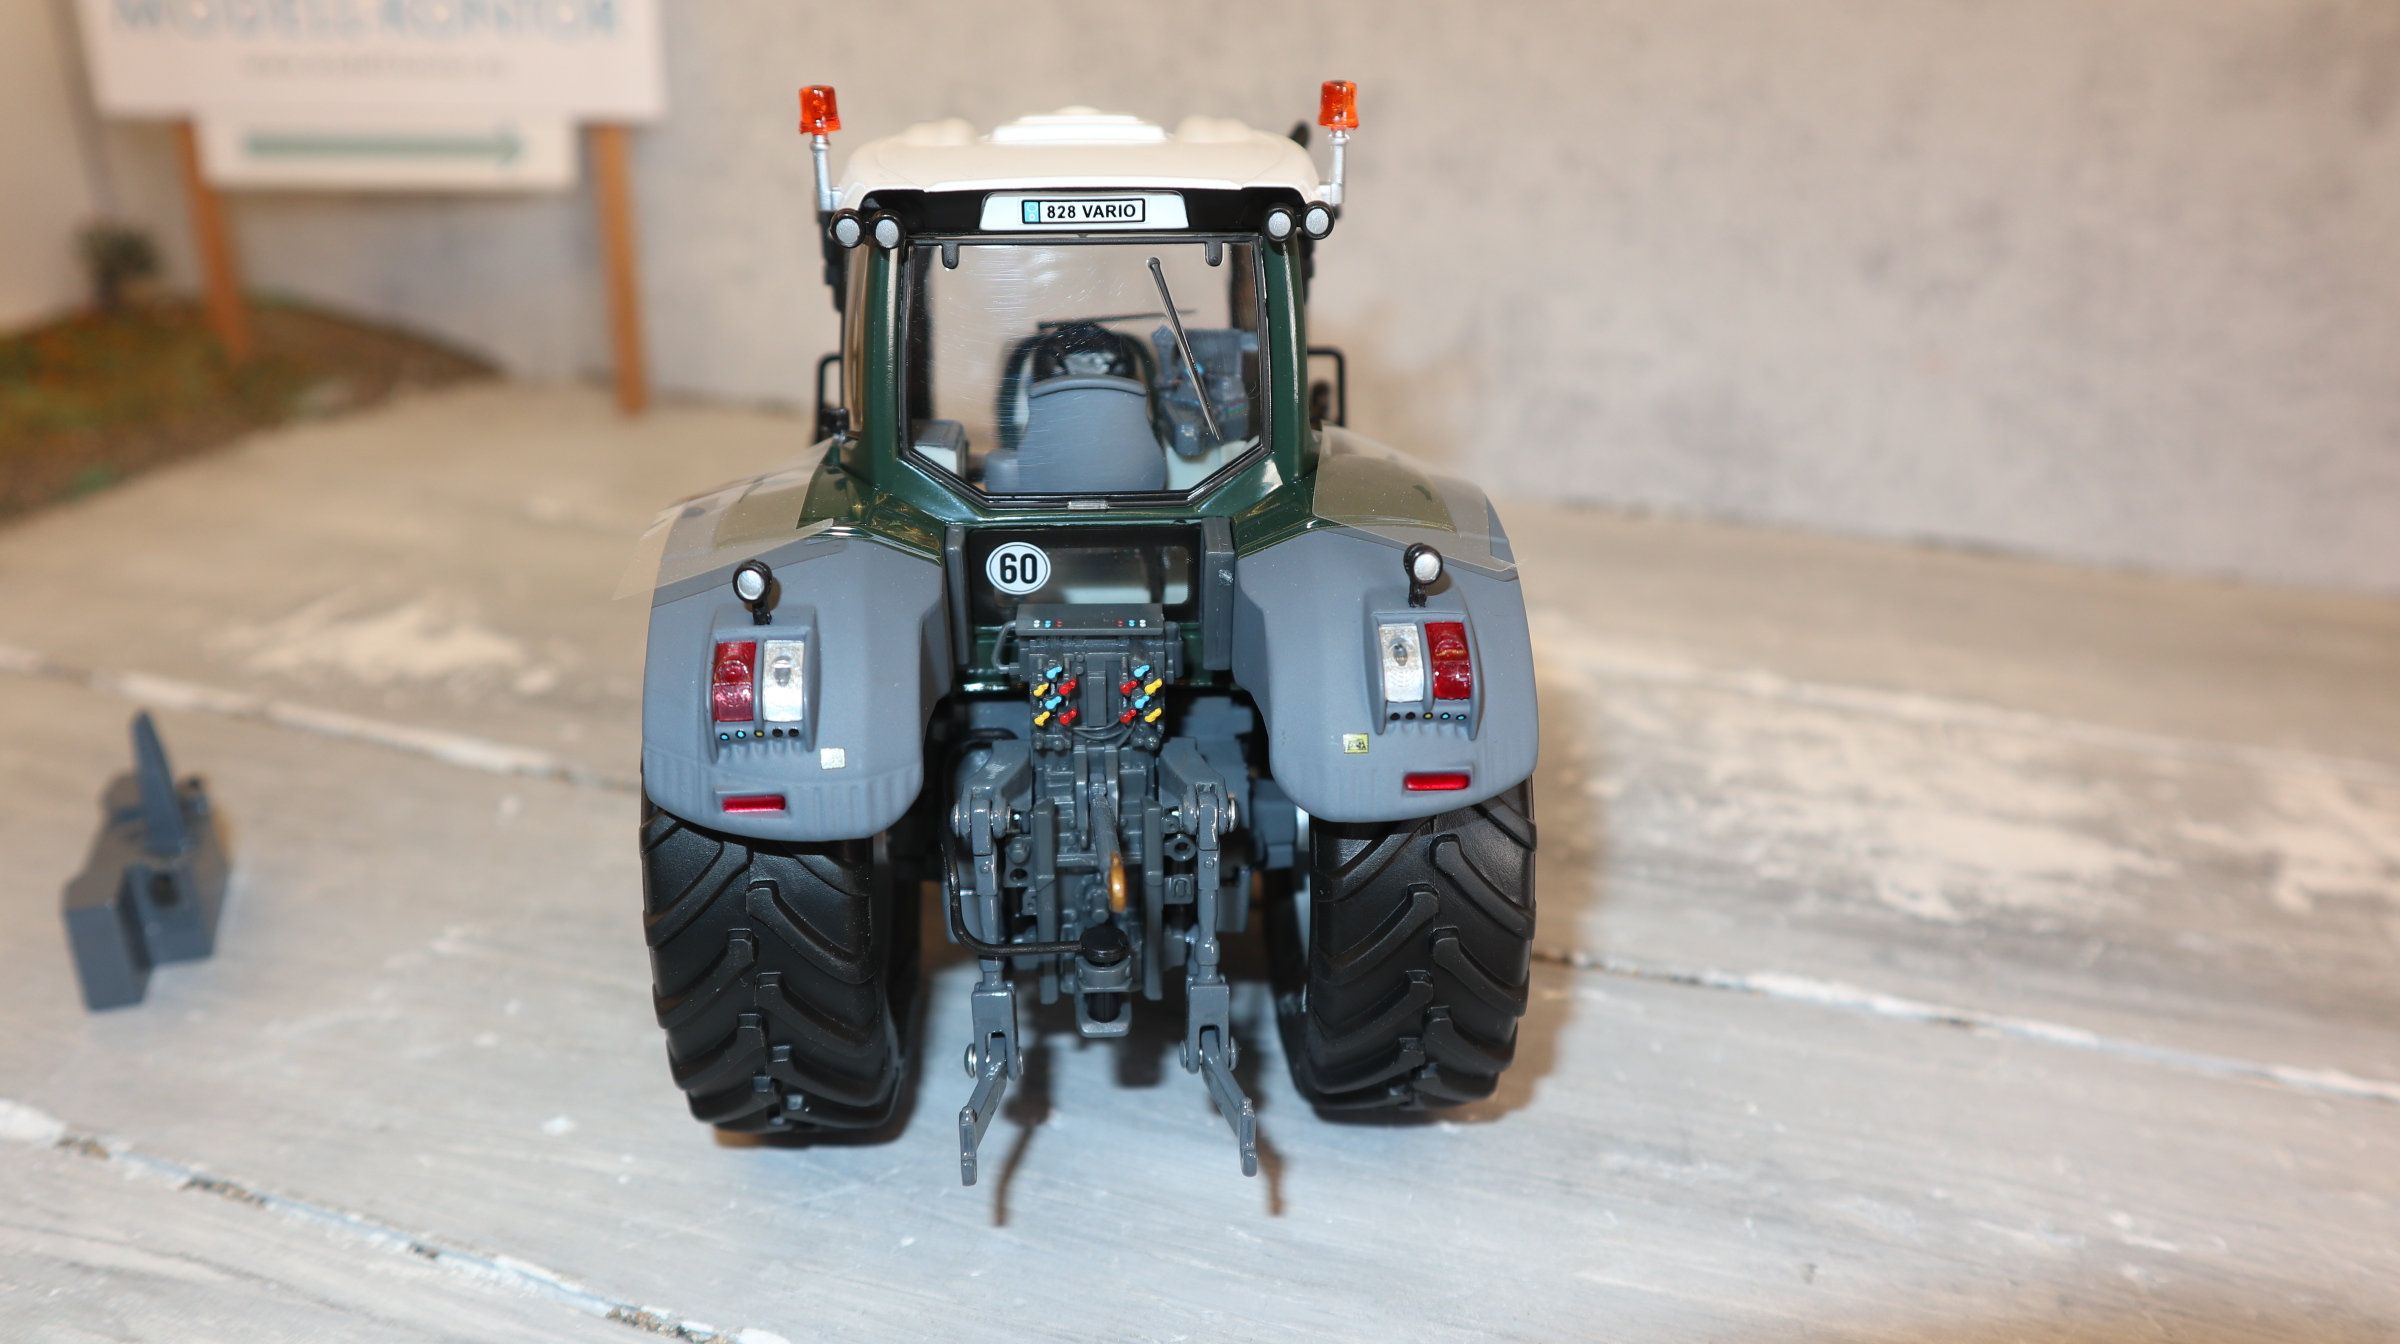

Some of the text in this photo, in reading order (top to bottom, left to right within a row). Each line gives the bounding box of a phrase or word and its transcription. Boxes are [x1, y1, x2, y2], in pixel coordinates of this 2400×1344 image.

[1047, 204, 1136, 218] 828 VARIO
[1001, 553, 1037, 584] 60
